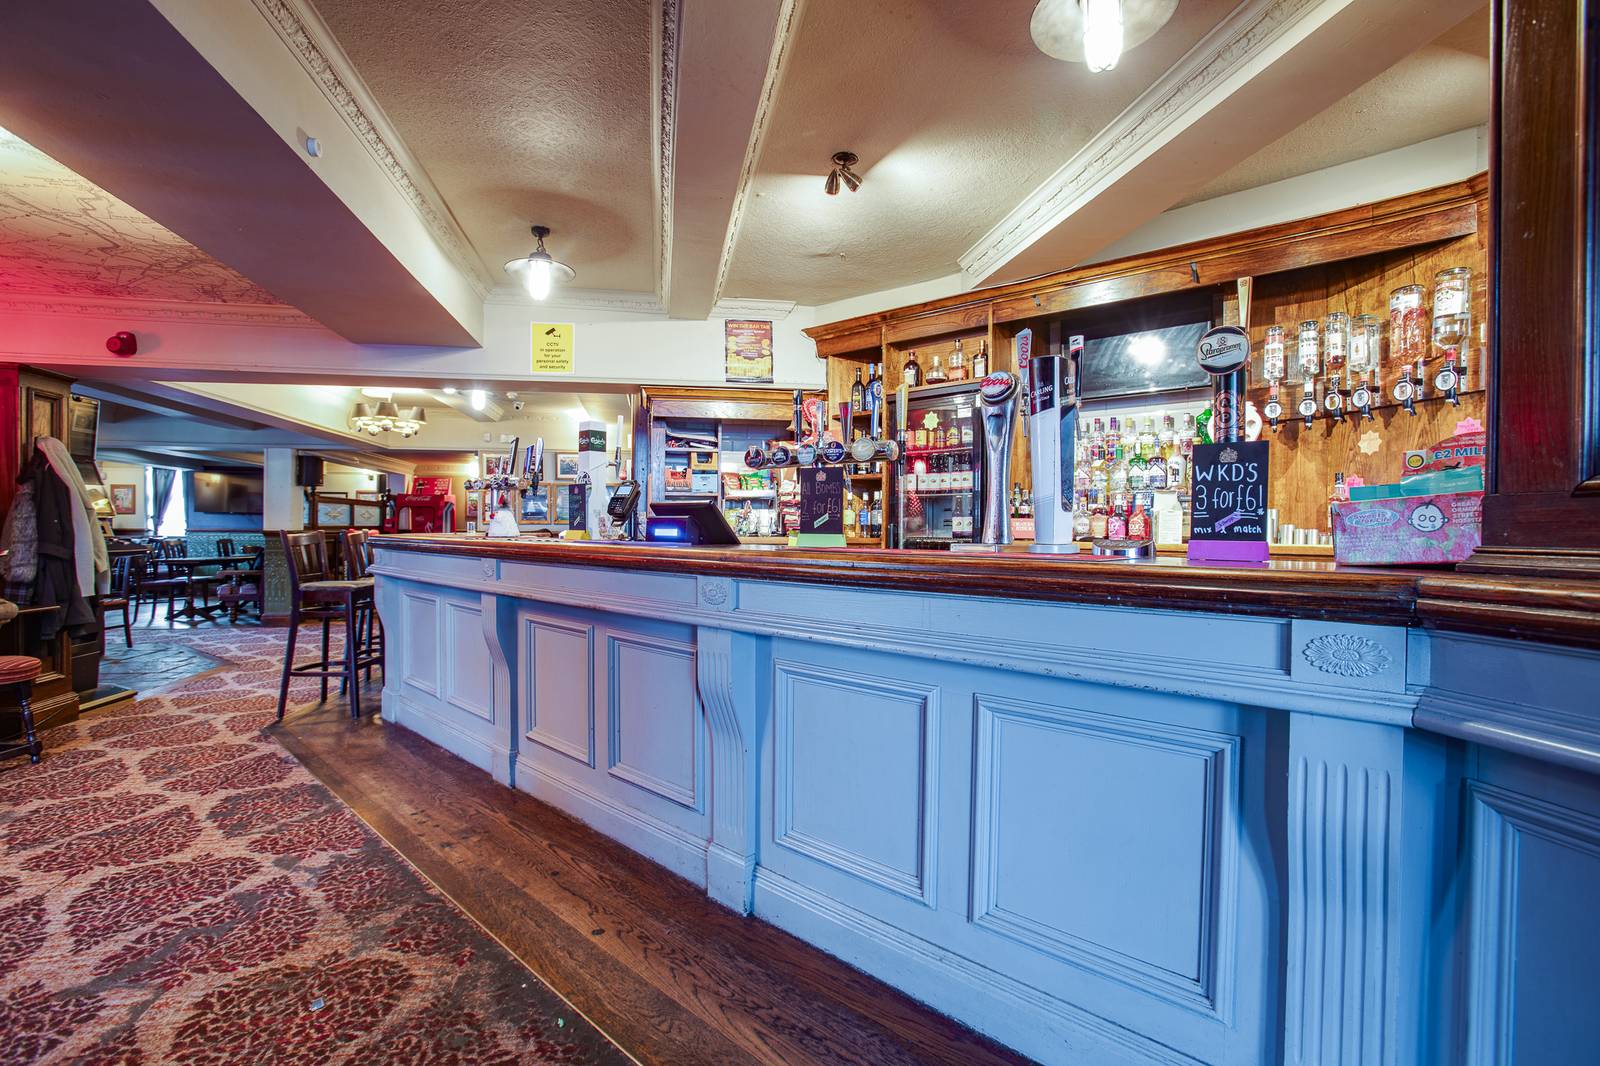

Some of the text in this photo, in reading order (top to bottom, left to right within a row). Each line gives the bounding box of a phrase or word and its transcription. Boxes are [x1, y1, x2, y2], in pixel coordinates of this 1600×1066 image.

[1019, 336, 1029, 369] Coors
[980, 376, 1012, 389] Coors
[1434, 449, 1452, 460] £2
[1195, 463, 1258, 483] WKD'S
[1195, 484, 1207, 510] 3
[1211, 487, 1235, 509] for
[1193, 526, 1212, 534] mix
[1233, 524, 1262, 534] match
